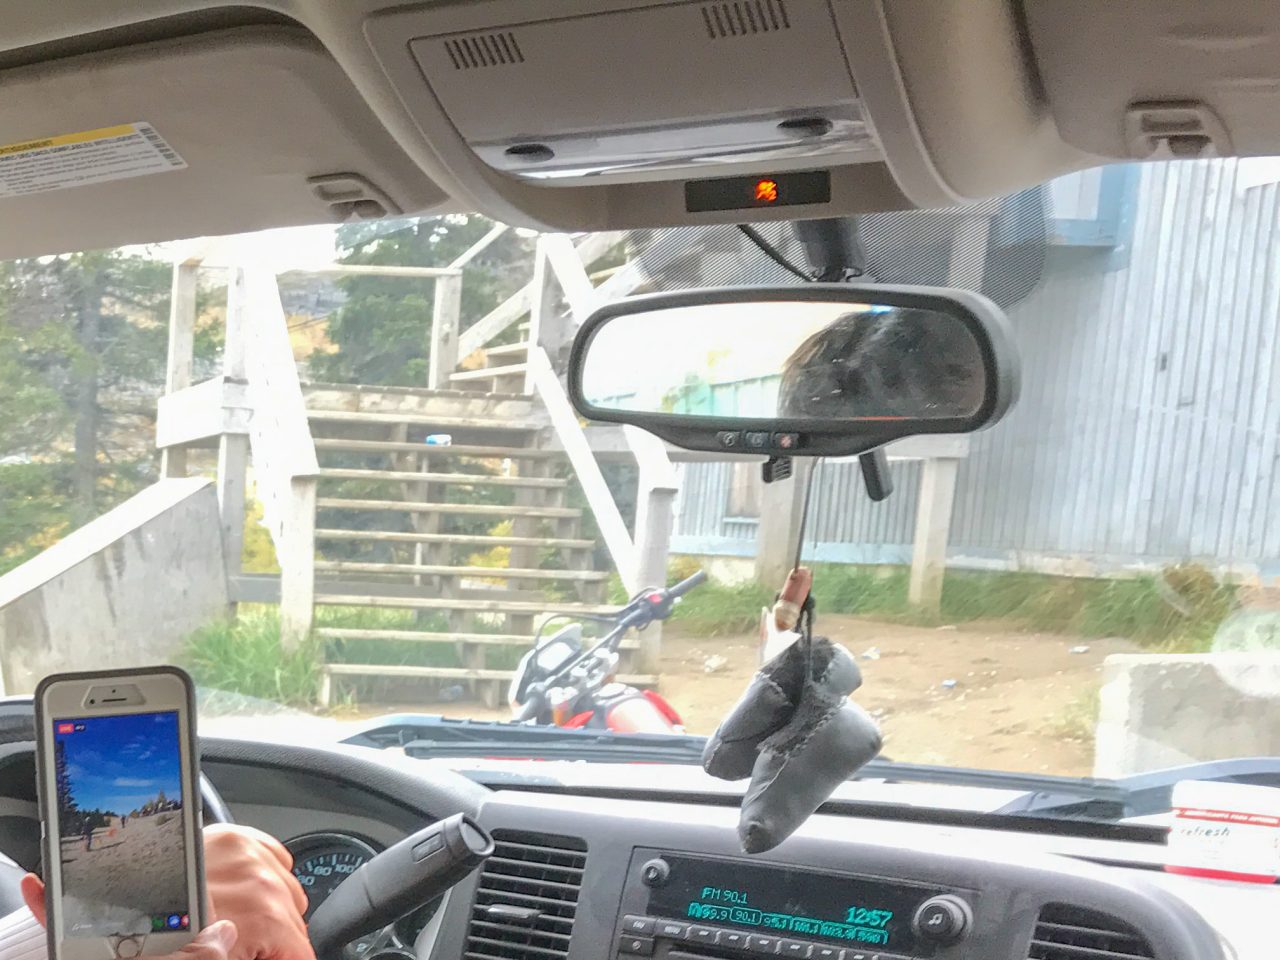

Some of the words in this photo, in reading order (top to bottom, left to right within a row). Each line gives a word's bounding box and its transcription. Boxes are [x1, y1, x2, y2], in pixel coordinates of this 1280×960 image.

[1181, 826, 1231, 837] refresh
[701, 887, 721, 900] FM
[723, 890, 748, 905] 90.1
[735, 910, 756, 923] 90.1
